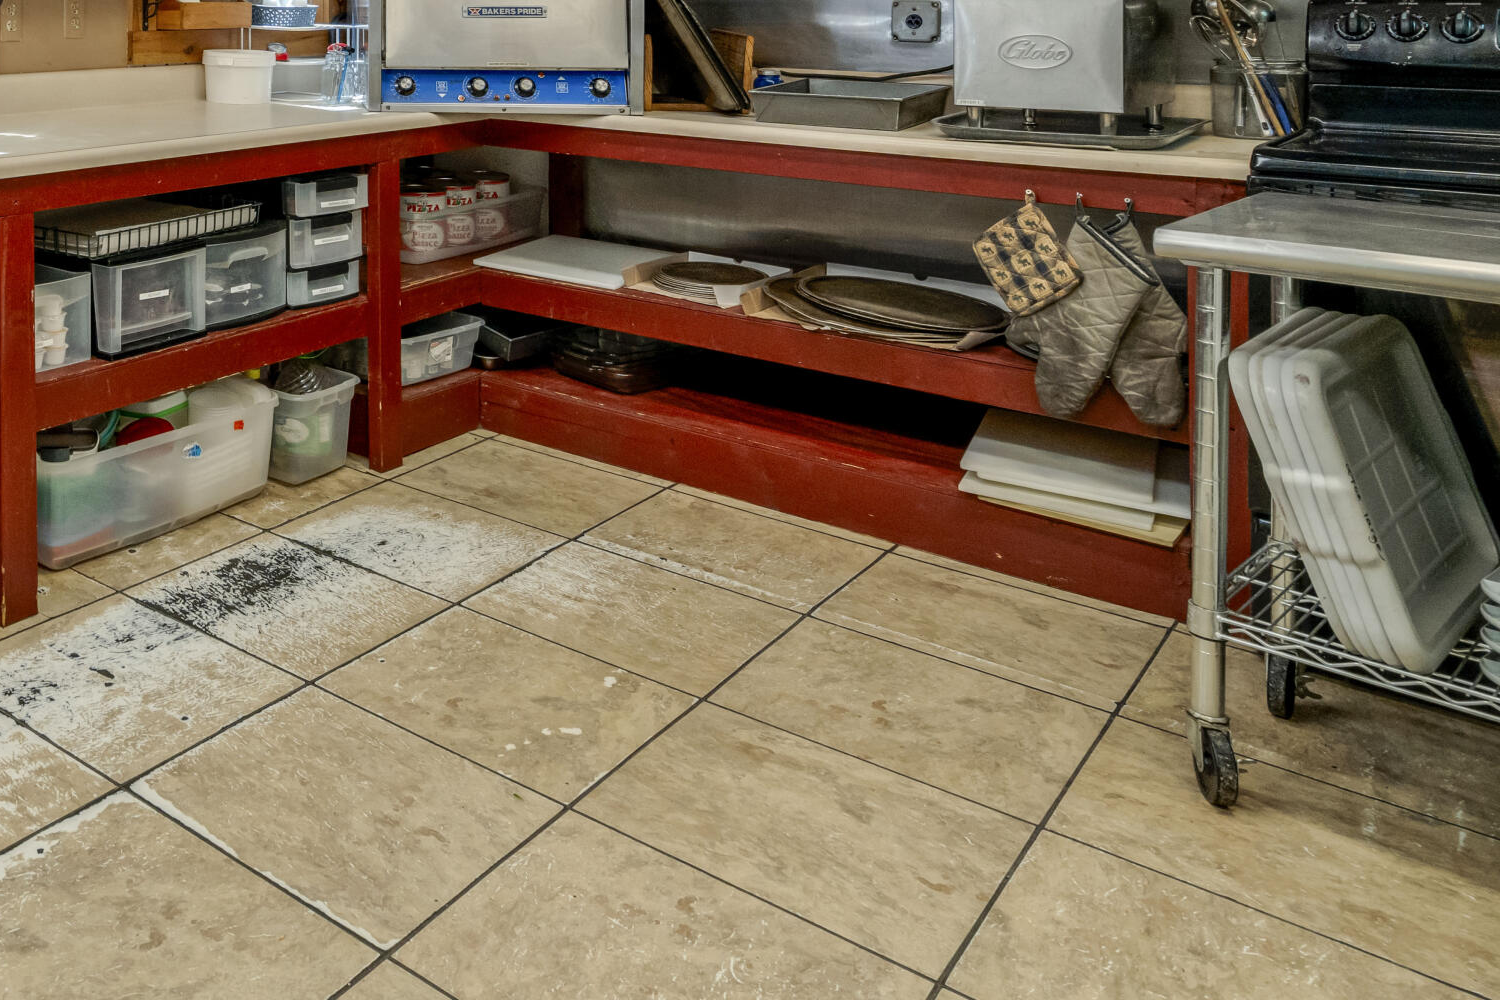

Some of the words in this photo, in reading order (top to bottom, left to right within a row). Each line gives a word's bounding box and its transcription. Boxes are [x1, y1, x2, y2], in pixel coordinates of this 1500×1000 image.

[481, 7, 516, 15] BAKERS
[517, 7, 542, 15] PRIDE
[1002, 39, 1067, 61] Globe
[406, 204, 440, 213] PIZZA
